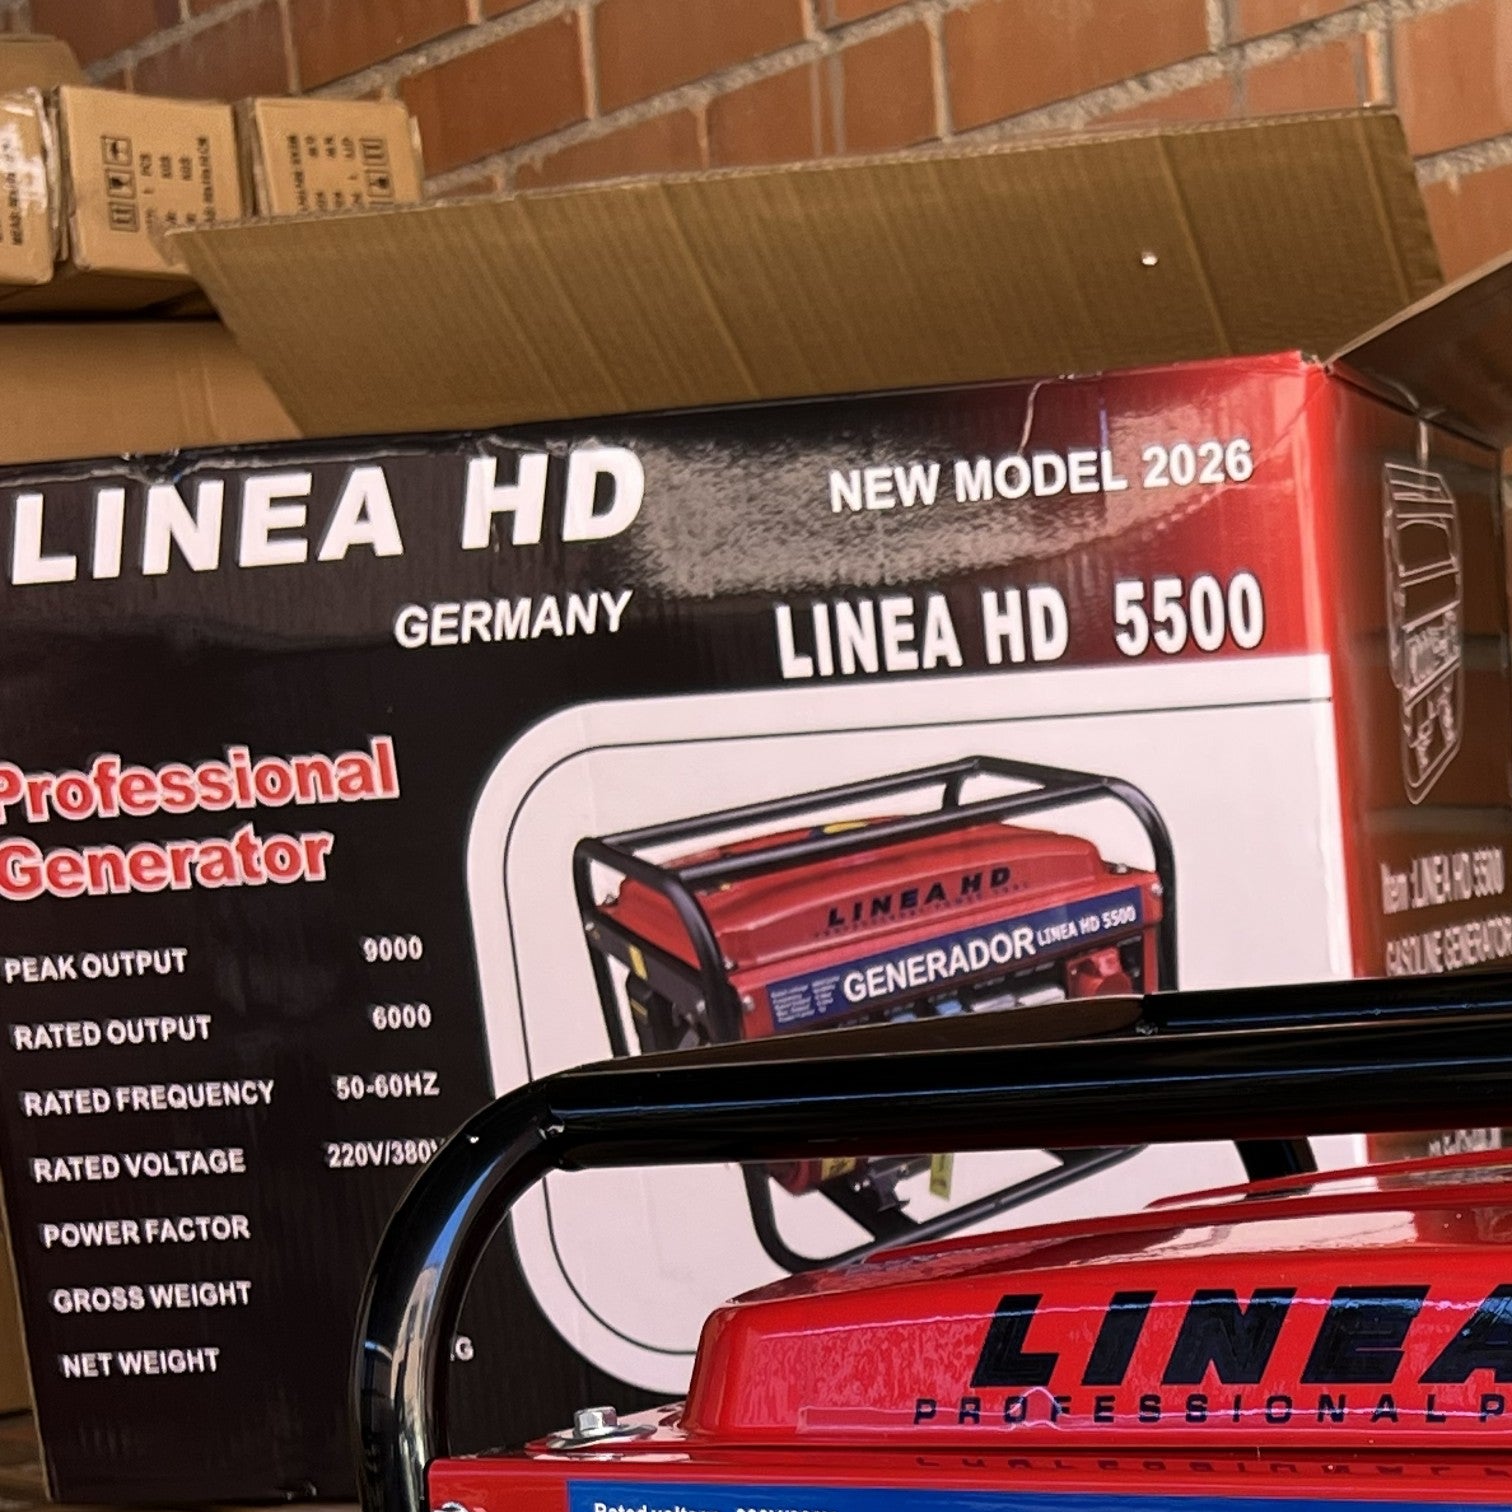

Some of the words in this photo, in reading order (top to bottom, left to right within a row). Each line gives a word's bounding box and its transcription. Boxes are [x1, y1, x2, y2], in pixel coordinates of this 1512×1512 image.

[829, 464, 940, 513] NEW
[954, 449, 1128, 503] MODEL
[1141, 438, 1254, 488] 2026
[11, 465, 403, 586] LINEA
[461, 446, 646, 550] HD
[394, 590, 634, 649] GERMANY
[775, 590, 962, 679] LINEA
[985, 584, 1069, 664] HD
[1113, 571, 1265, 657] 5500
[0, 734, 400, 825] Professional
[0, 823, 335, 900] Generator
[828, 882, 946, 927] LINEA
[960, 866, 1011, 896] HD
[4, 954, 77, 984] PEAK
[82, 948, 188, 978] OUTPUT
[363, 936, 424, 963] 9000
[843, 925, 1036, 1003] GENERADOR
[1036, 919, 1078, 947] LINEA
[1101, 904, 1137, 930] 5500
[14, 1023, 101, 1050] RATED
[107, 1016, 212, 1045] OUTPUT
[372, 1003, 431, 1030] 6000
[23, 1090, 111, 1116] RATED
[116, 1080, 274, 1111] FREQUENCY
[336, 1072, 440, 1099] 50-60HZ
[34, 1155, 120, 1182] RATED
[127, 1149, 246, 1178] VOLTAGE
[43, 1221, 140, 1248] POWER
[145, 1215, 250, 1243] FACTOR
[53, 1287, 145, 1313] GROSS
[151, 1281, 252, 1309] WEIGHT
[62, 1353, 112, 1378] NET
[118, 1347, 220, 1375] WEIGHT
